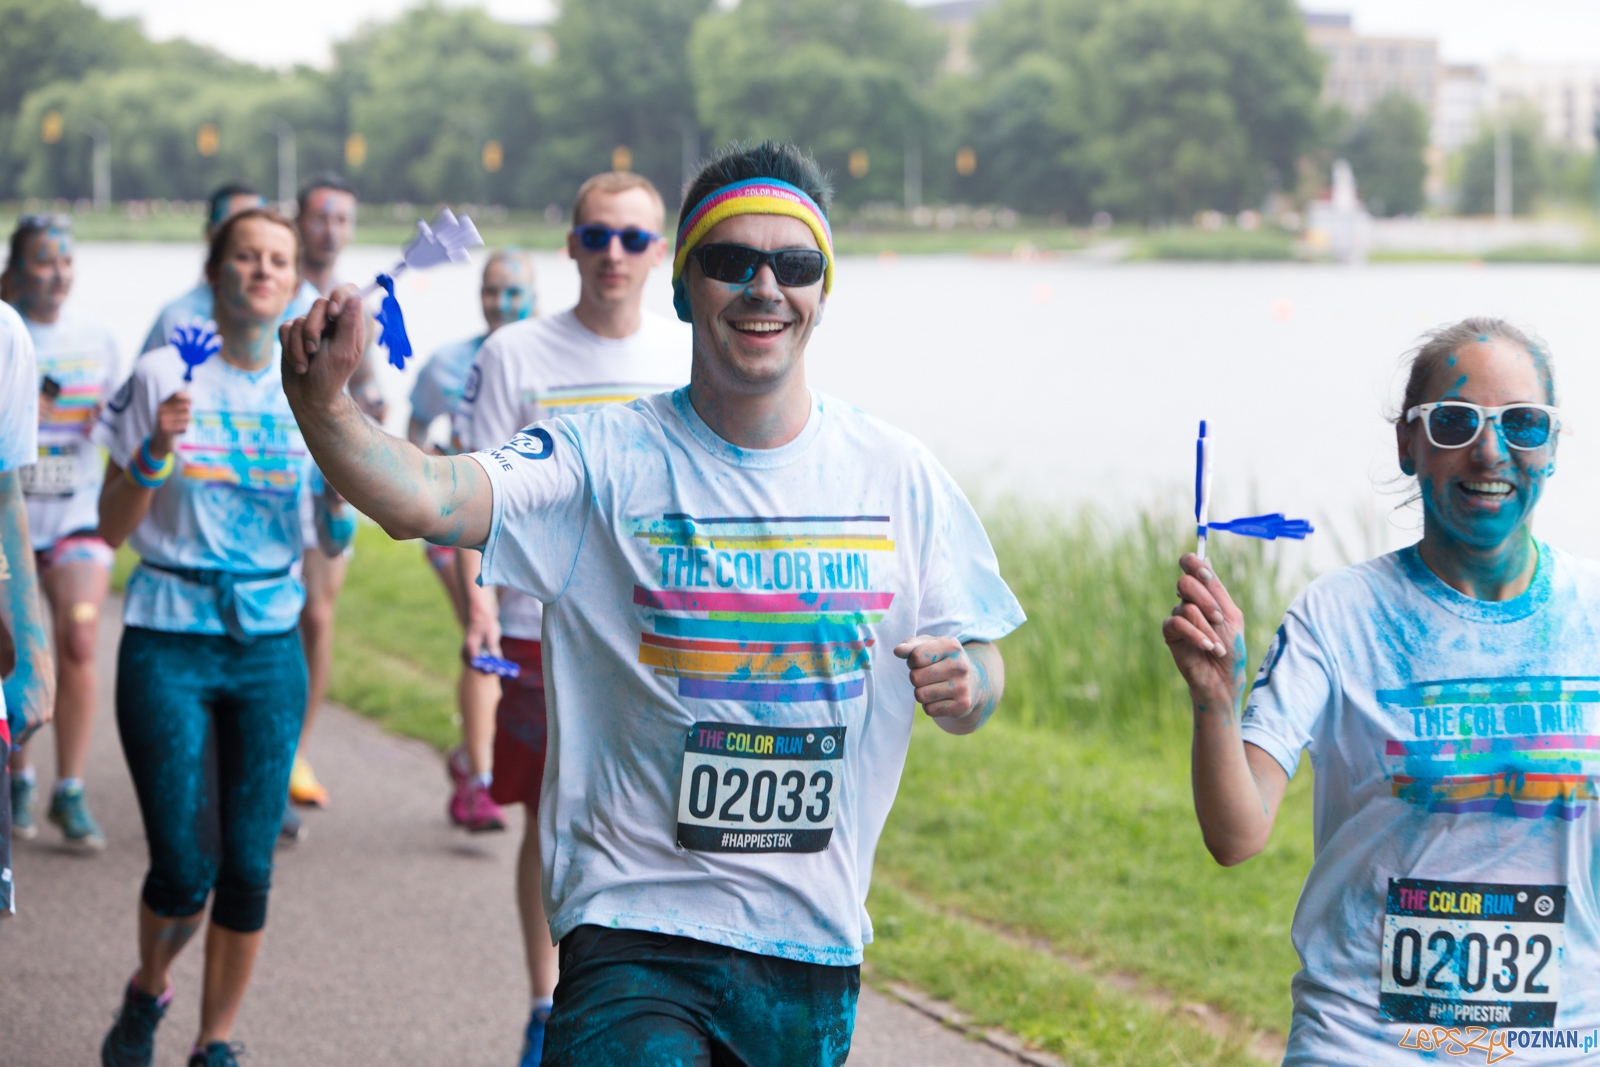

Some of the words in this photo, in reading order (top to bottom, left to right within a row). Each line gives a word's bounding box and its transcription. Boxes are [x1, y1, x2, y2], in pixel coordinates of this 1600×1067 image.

[744, 187, 771, 197] COLOR
[657, 546, 709, 587] THE
[715, 551, 813, 590] COLOR
[1409, 706, 1454, 737] THE
[698, 729, 726, 750] THE
[726, 732, 774, 755] COLOR
[775, 735, 804, 755] RUN
[688, 764, 833, 823] 02033
[721, 832, 794, 849] #HAPPIEST5K
[1398, 888, 1428, 911] THE
[1428, 890, 1483, 915] COLOR
[1391, 927, 1553, 994] 02032
